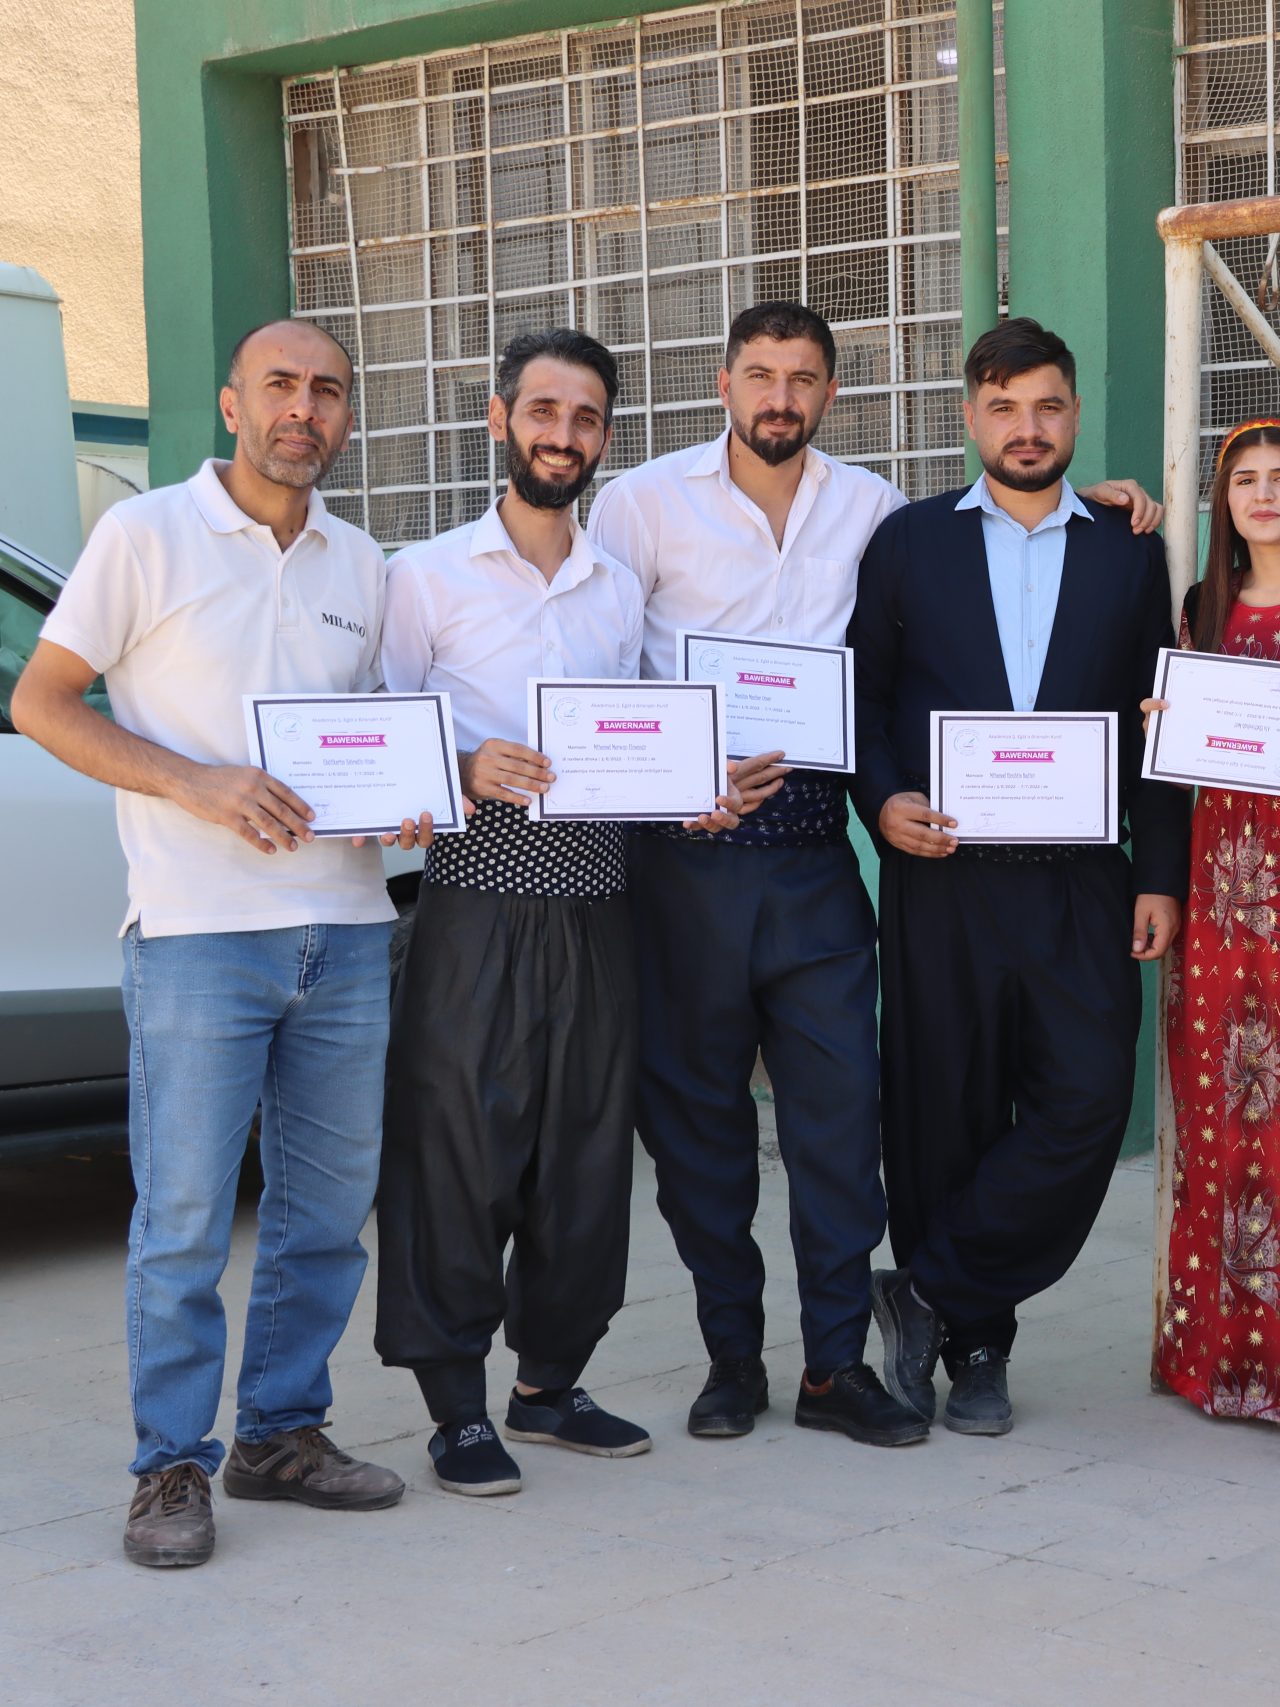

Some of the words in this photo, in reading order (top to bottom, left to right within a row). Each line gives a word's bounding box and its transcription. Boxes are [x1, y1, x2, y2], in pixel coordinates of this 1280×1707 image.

[321, 612, 366, 638] MILANO
[743, 674, 791, 685] BAWERNAME
[603, 721, 656, 730] BAWERNAME
[326, 735, 380, 745] BAWERNAME
[1210, 739, 1258, 752] BAWERNAME
[999, 751, 1049, 760] BAWERNAME
